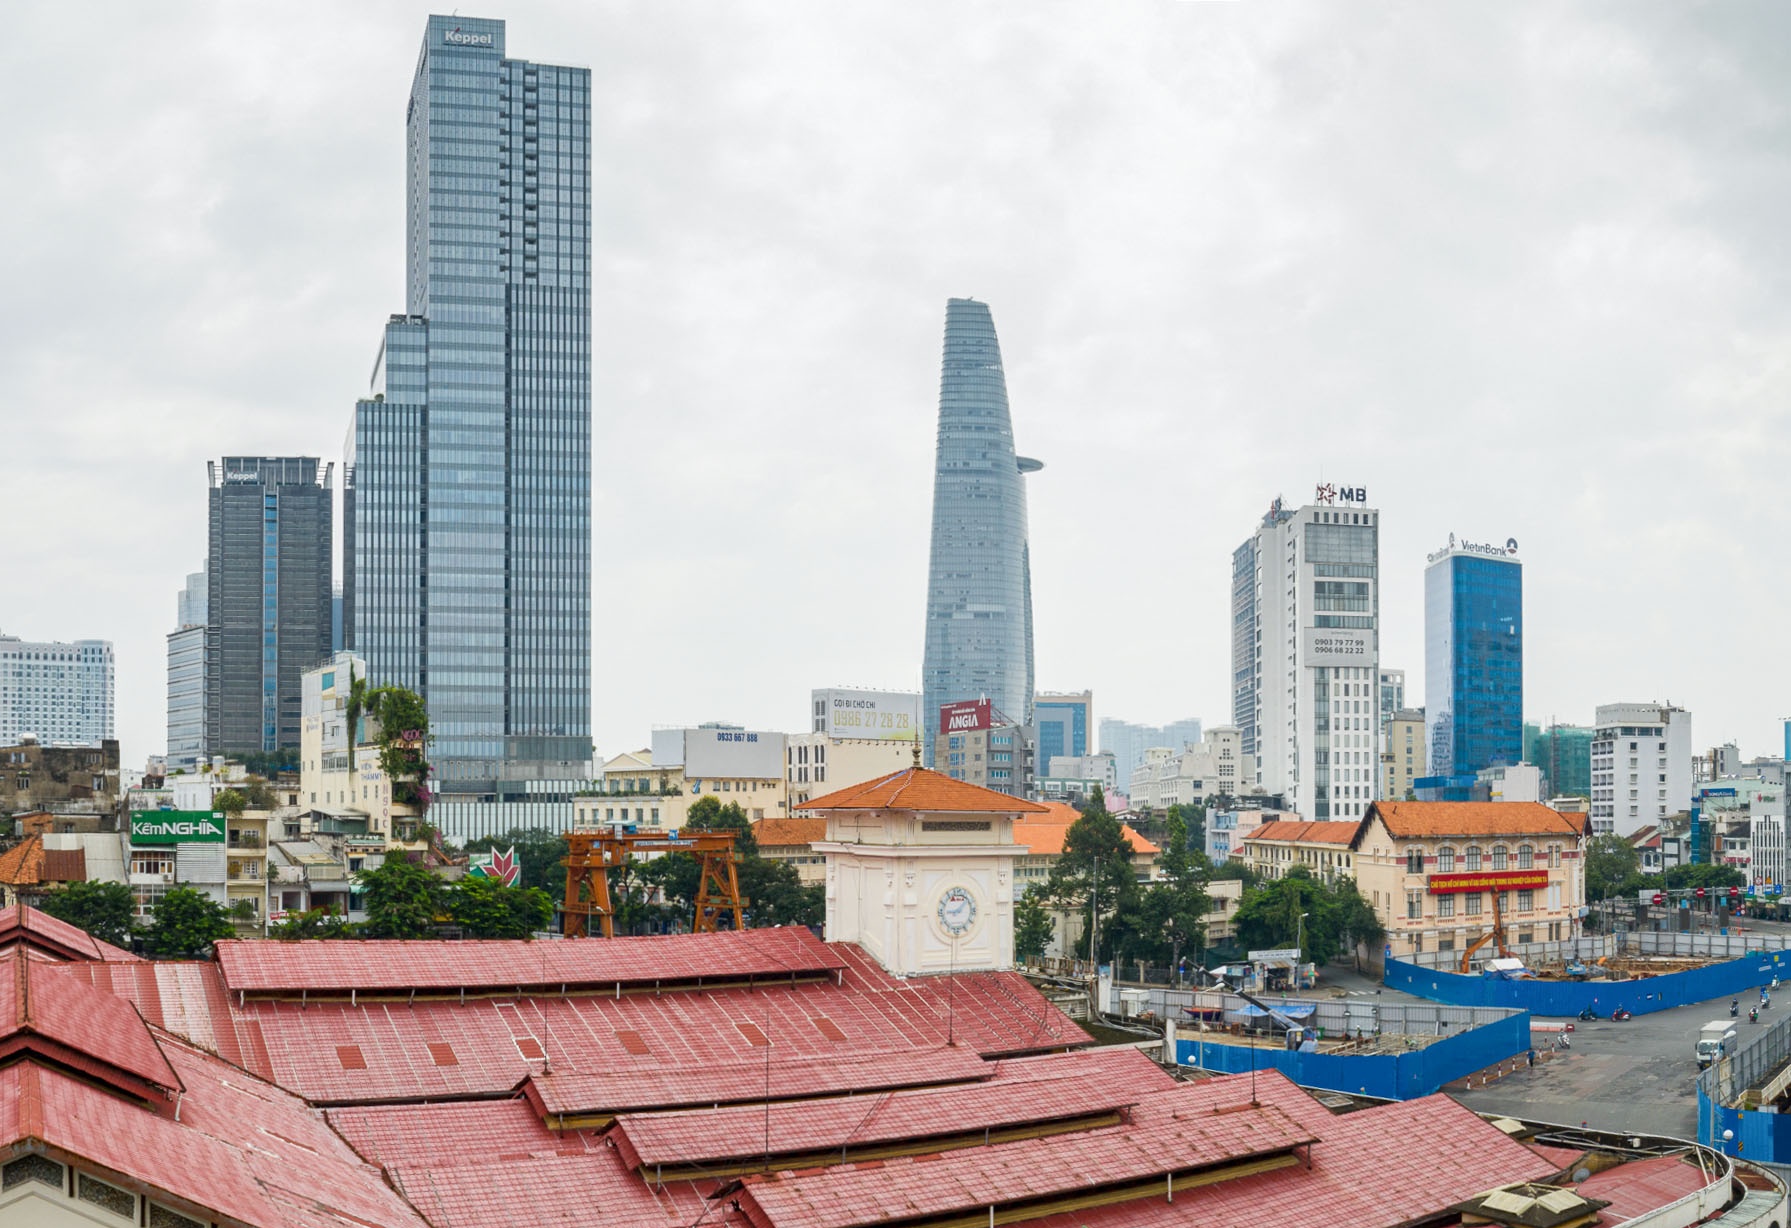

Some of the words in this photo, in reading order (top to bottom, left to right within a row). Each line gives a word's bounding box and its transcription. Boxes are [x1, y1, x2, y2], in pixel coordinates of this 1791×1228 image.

[445, 30, 492, 44] Keppel
[227, 471, 258, 480] Keppel
[1340, 488, 1366, 502] MB
[1461, 539, 1506, 556] VietinBank
